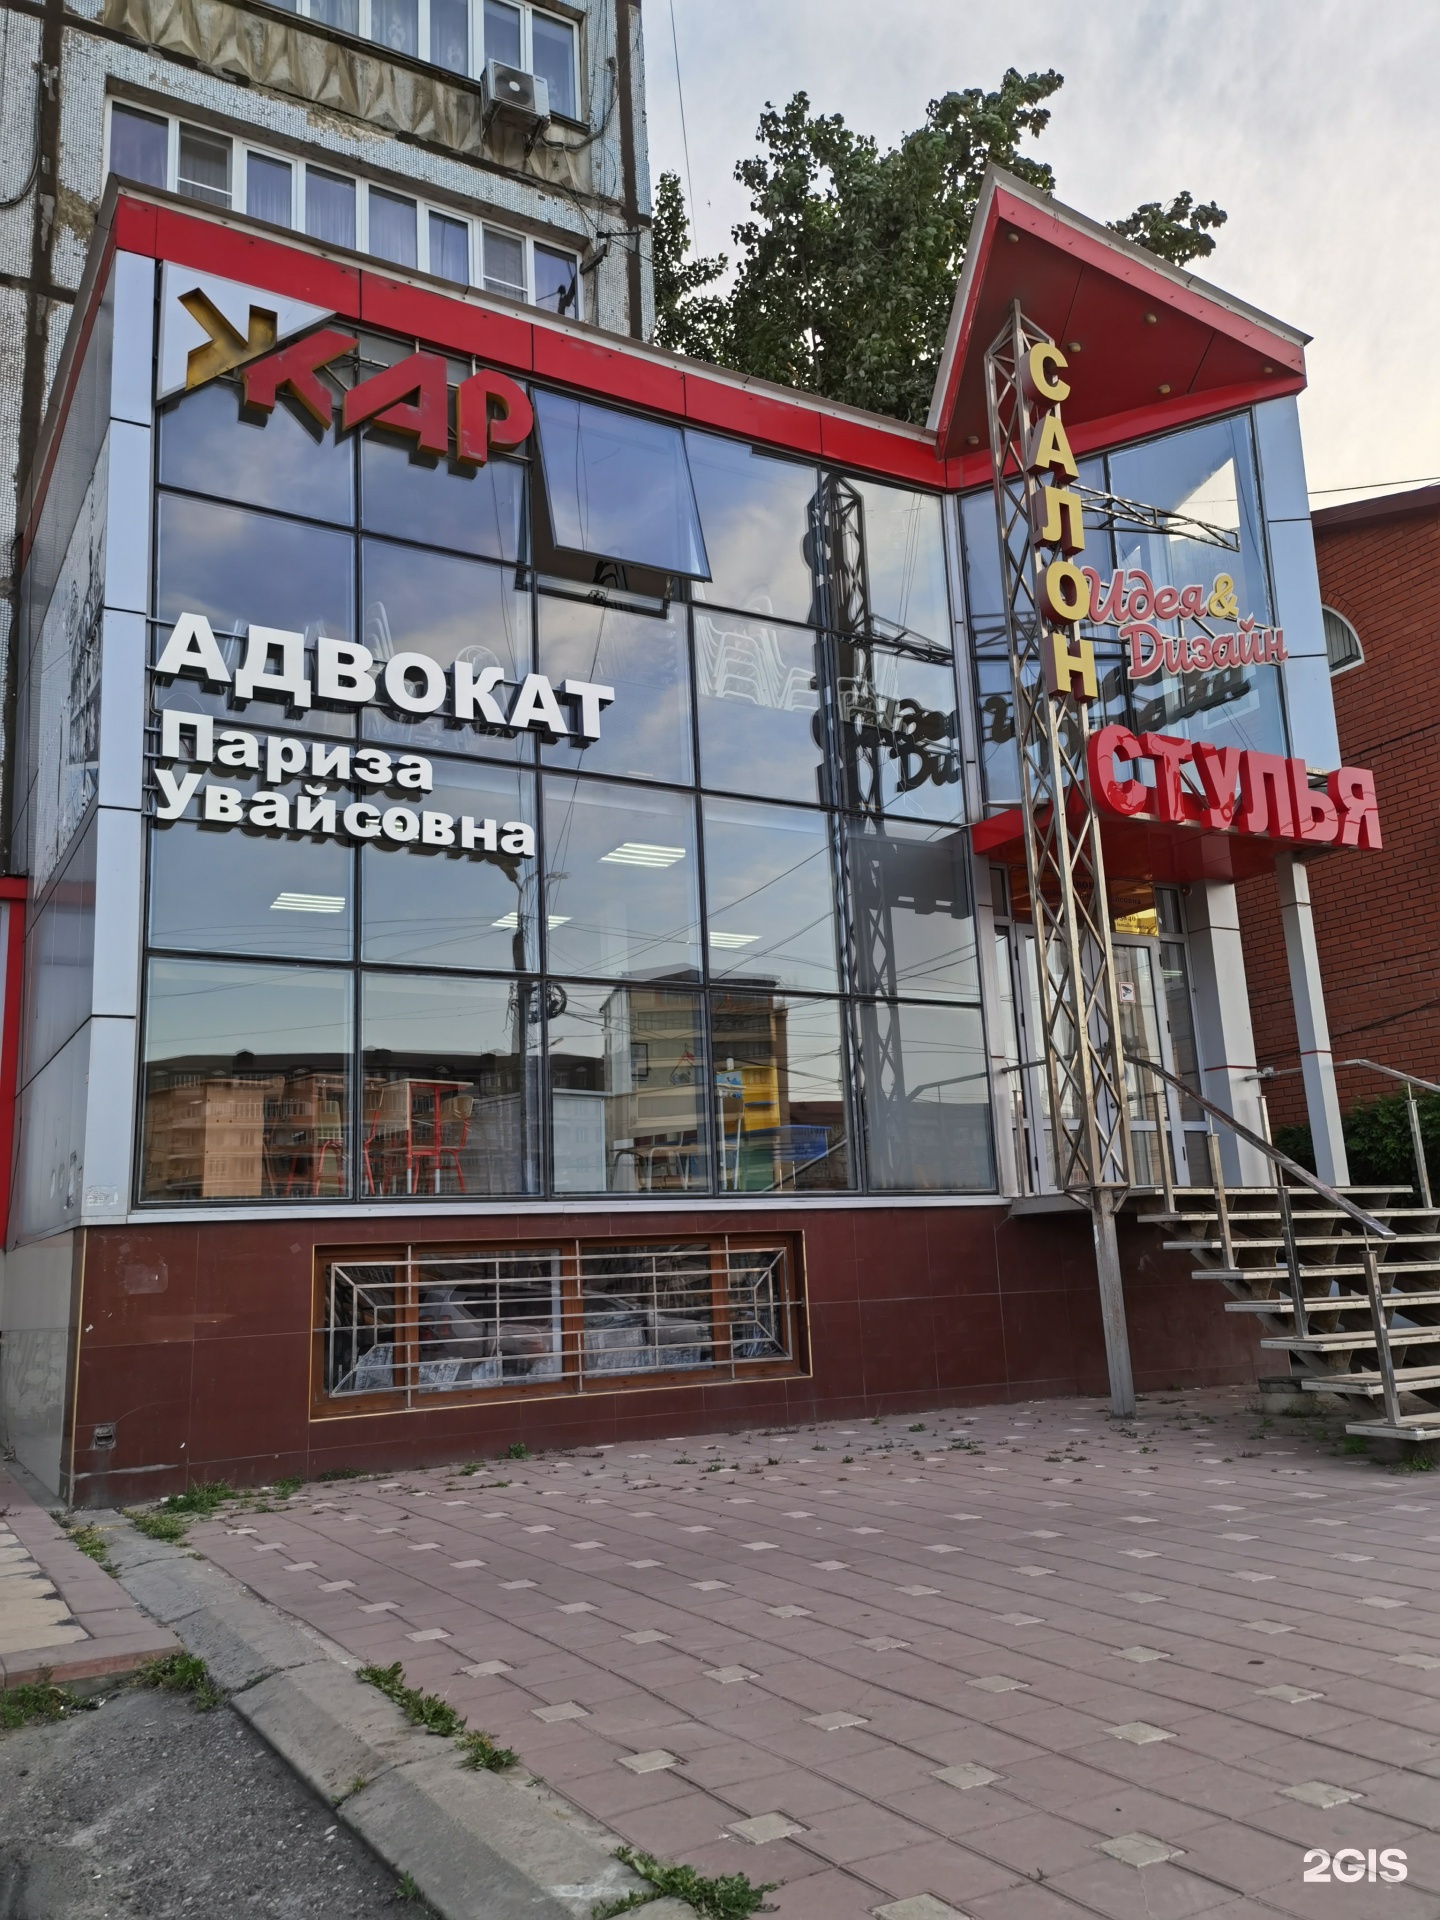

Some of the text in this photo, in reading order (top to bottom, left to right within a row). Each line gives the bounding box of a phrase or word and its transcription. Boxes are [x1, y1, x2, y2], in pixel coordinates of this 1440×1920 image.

[1022, 342, 1096, 702] САЛОН
[1080, 566, 1239, 624] Идея &
[1118, 612, 1288, 680] Дизайн
[154, 612, 616, 745] АДВОКАТ
[161, 709, 434, 793] Париза
[1088, 724, 1382, 850] СТУЛЬЯ
